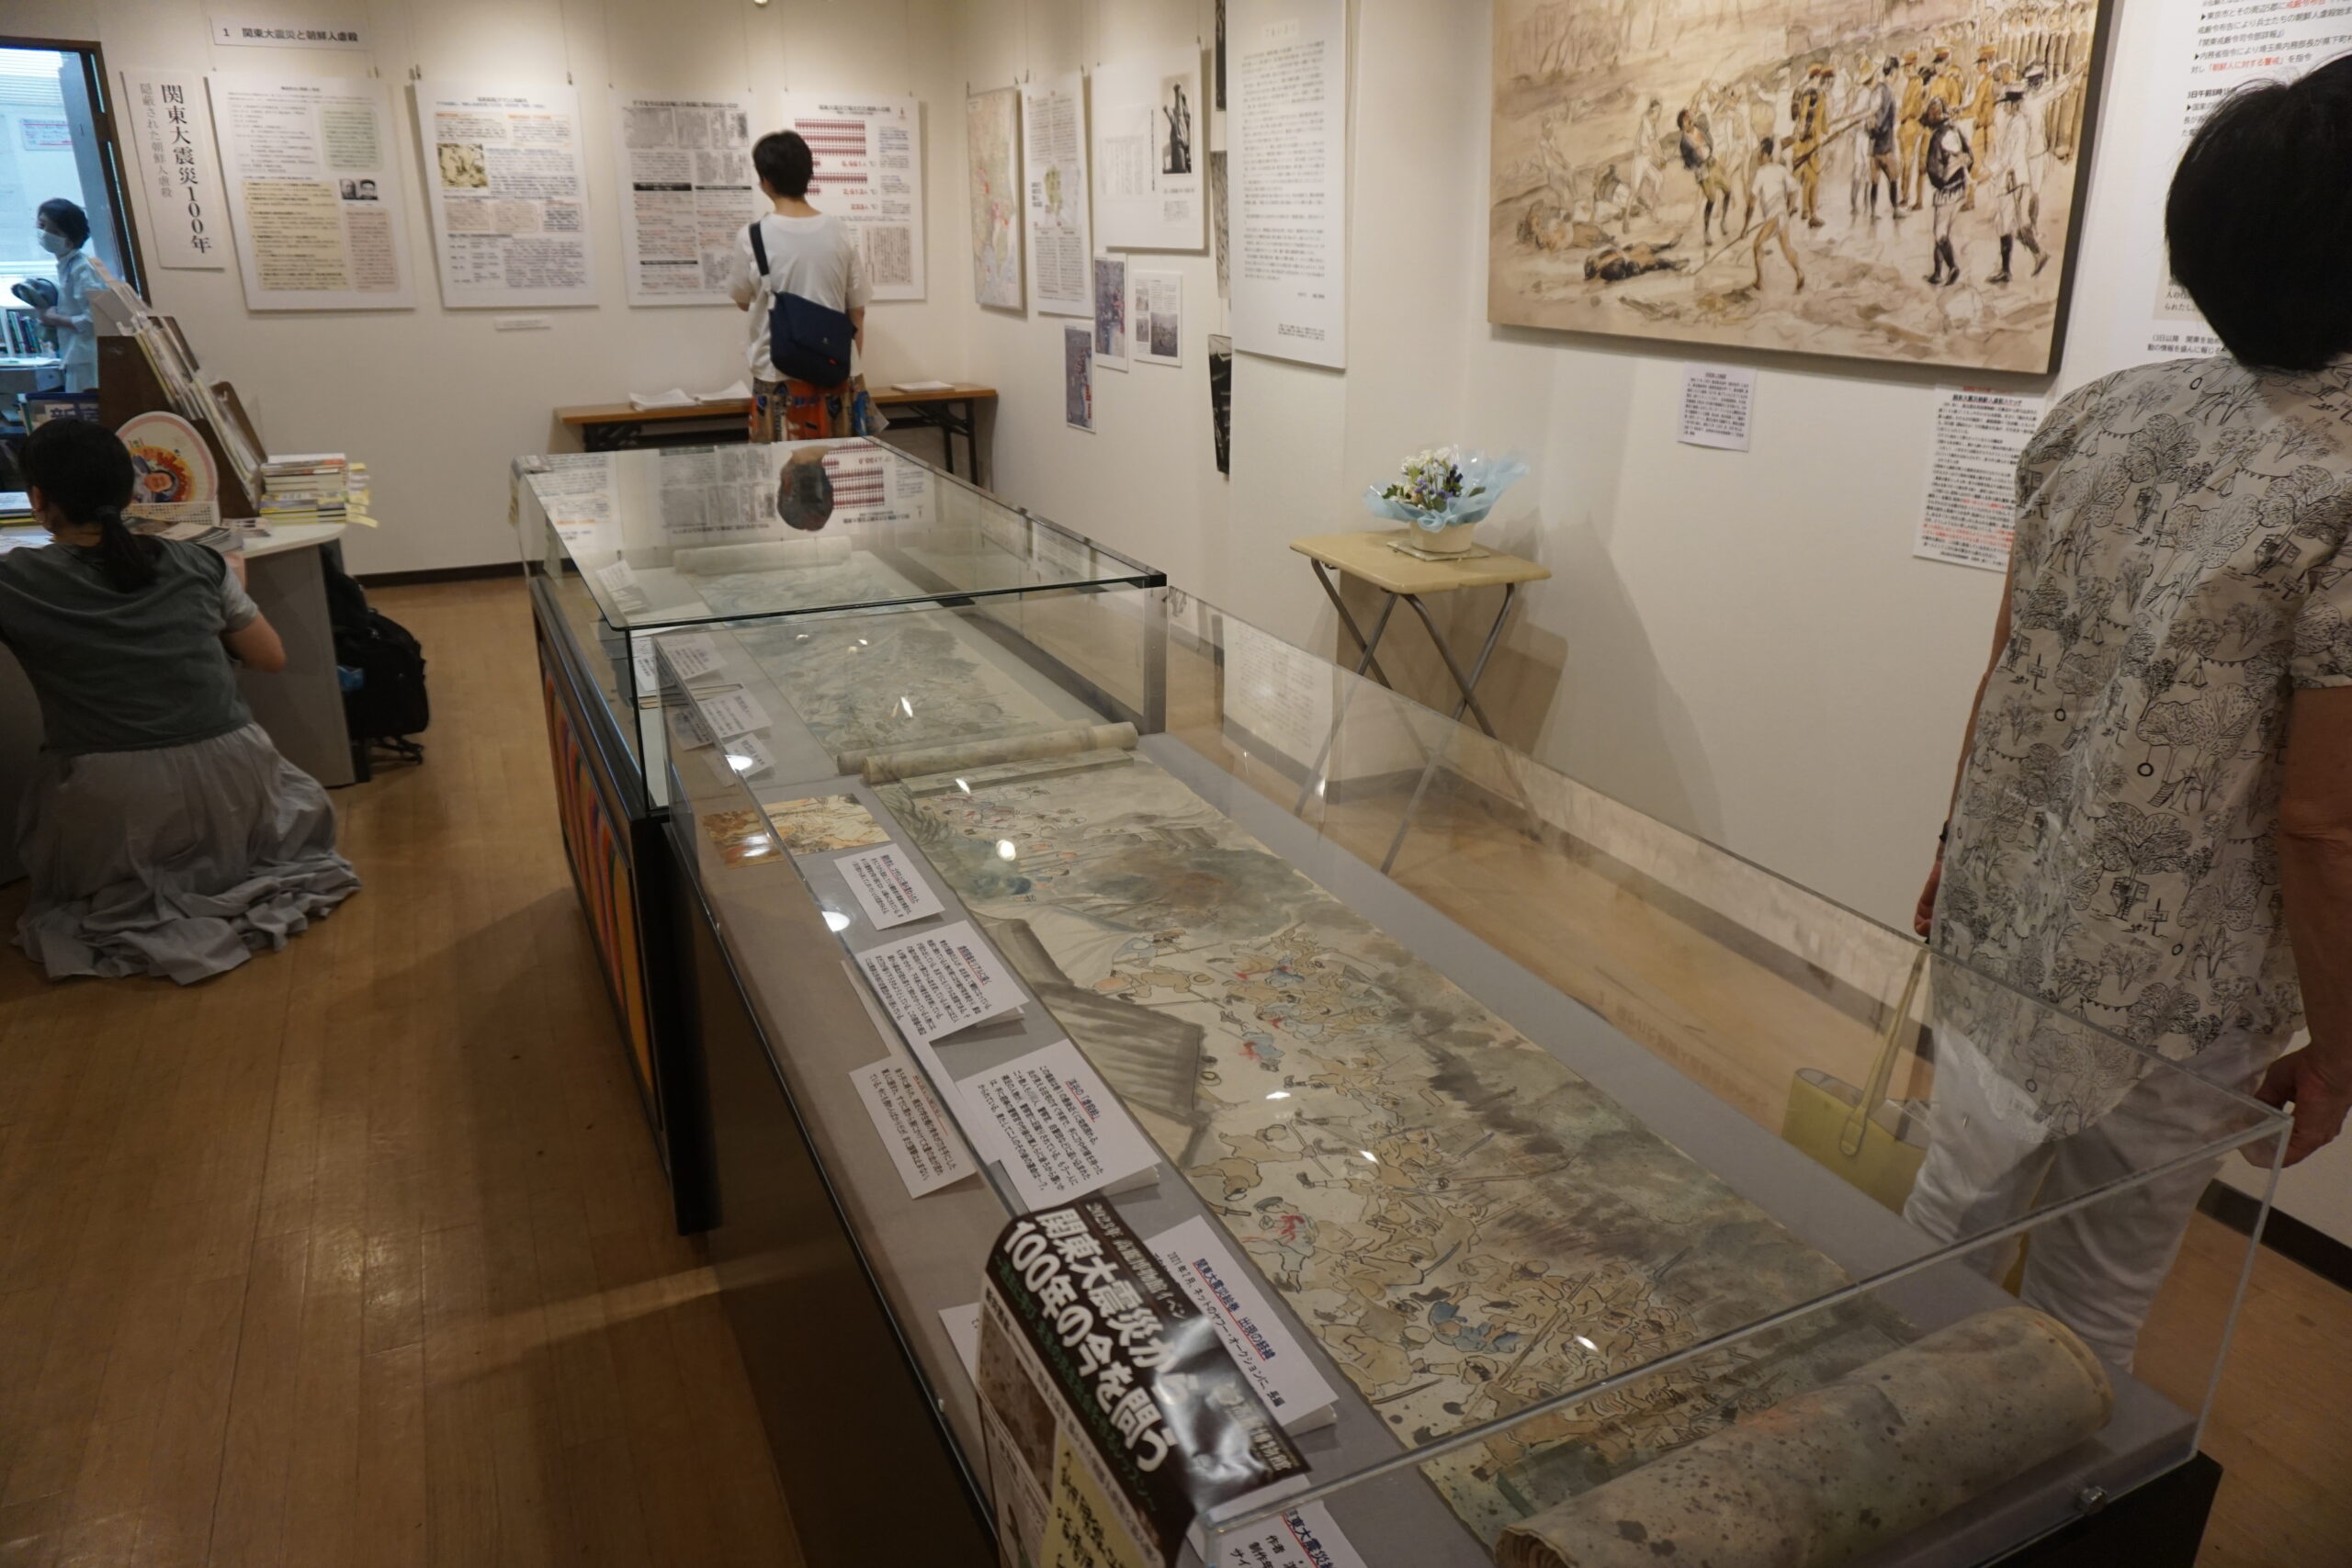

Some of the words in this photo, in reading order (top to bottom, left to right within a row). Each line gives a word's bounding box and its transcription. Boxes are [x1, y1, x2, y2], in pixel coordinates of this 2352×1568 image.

[223, 28, 230, 37] 1
[242, 28, 358, 41] 関東大震災と朝鮮人虐殺
[161, 84, 212, 254] 関東大震災100年
[1035, 1209, 1201, 1405] 関東大震災から
[1193, 1257, 1241, 1313] 関東大震災絵巻
[1004, 1222, 1177, 1472] 100年の今を問う
[1266, 1535, 1285, 1553] 作者
